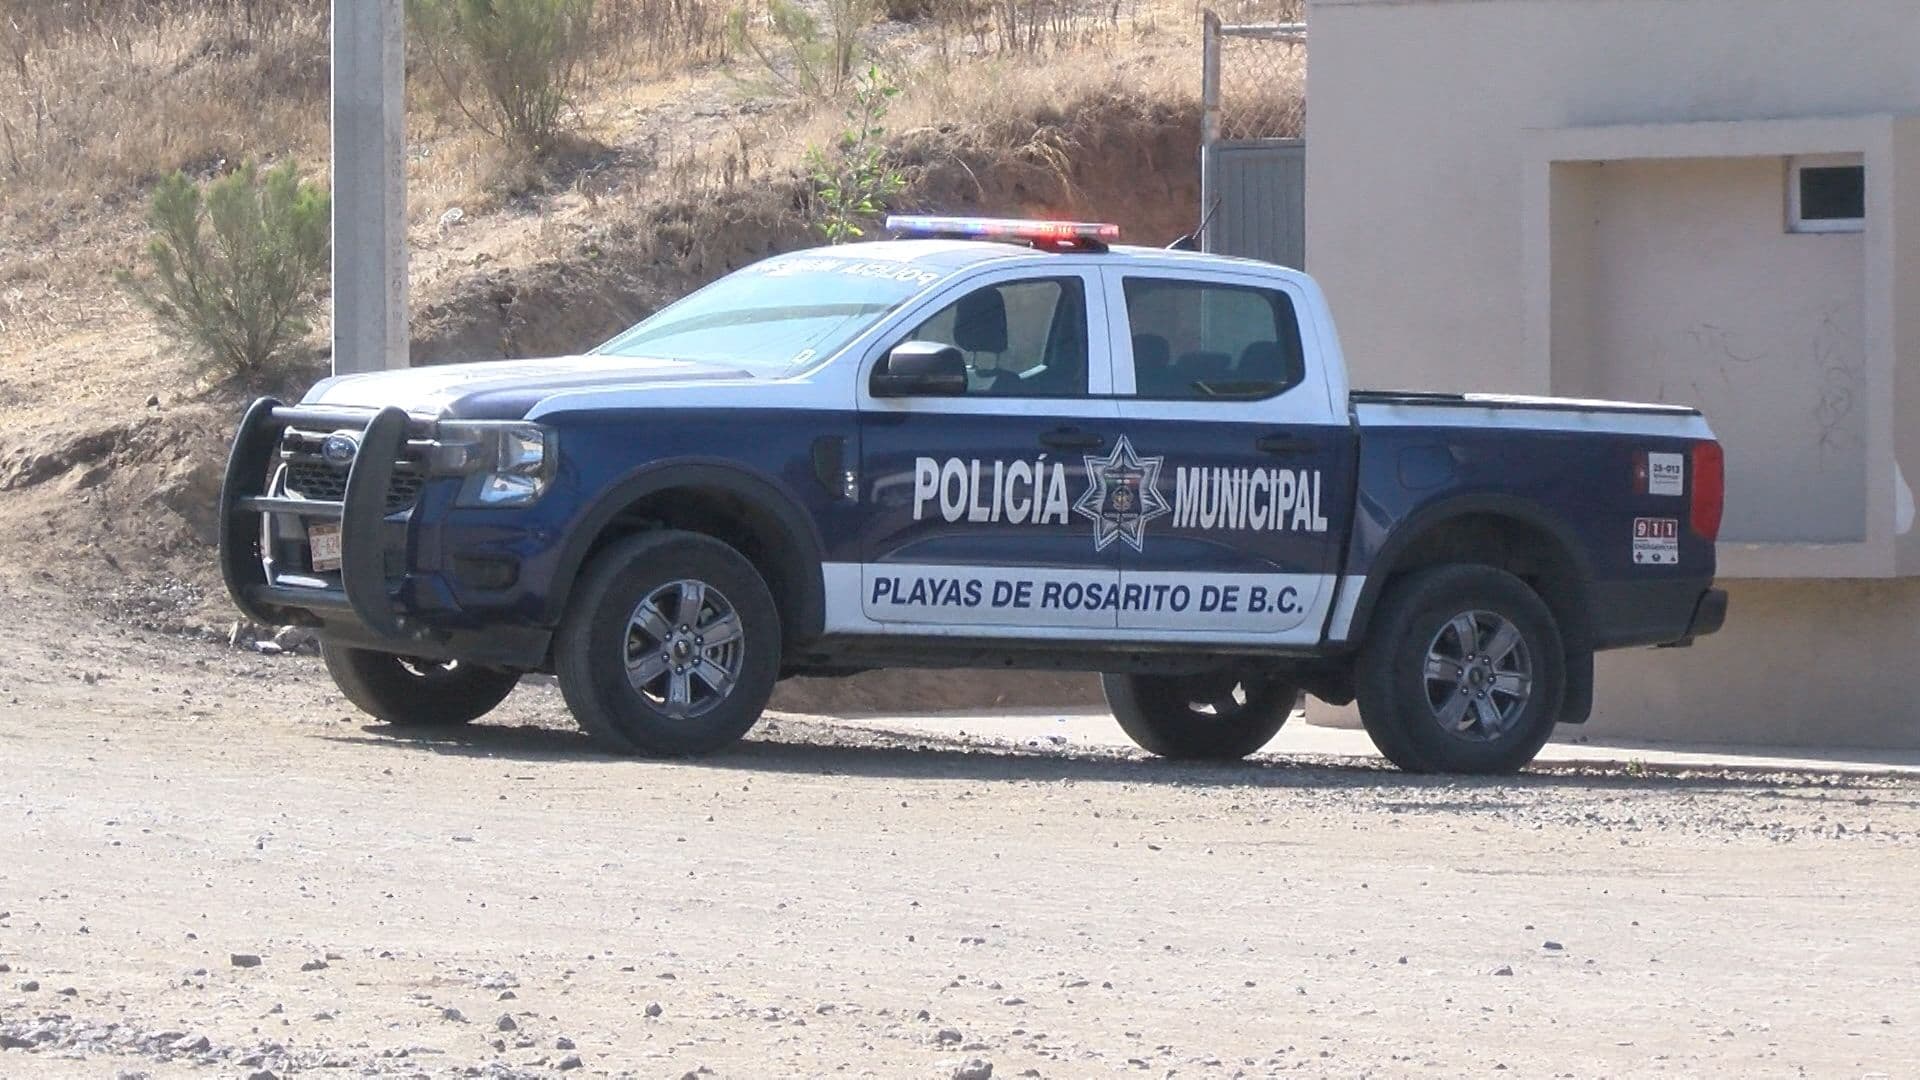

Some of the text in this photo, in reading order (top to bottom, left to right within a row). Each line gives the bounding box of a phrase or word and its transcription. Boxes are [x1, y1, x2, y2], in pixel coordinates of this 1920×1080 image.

[913, 454, 1328, 532] POLICÍA MUNICIPAL
[1637, 521, 1673, 536] 911
[872, 577, 1303, 613] PLAYAS DE ROSARITO DE B.C.
